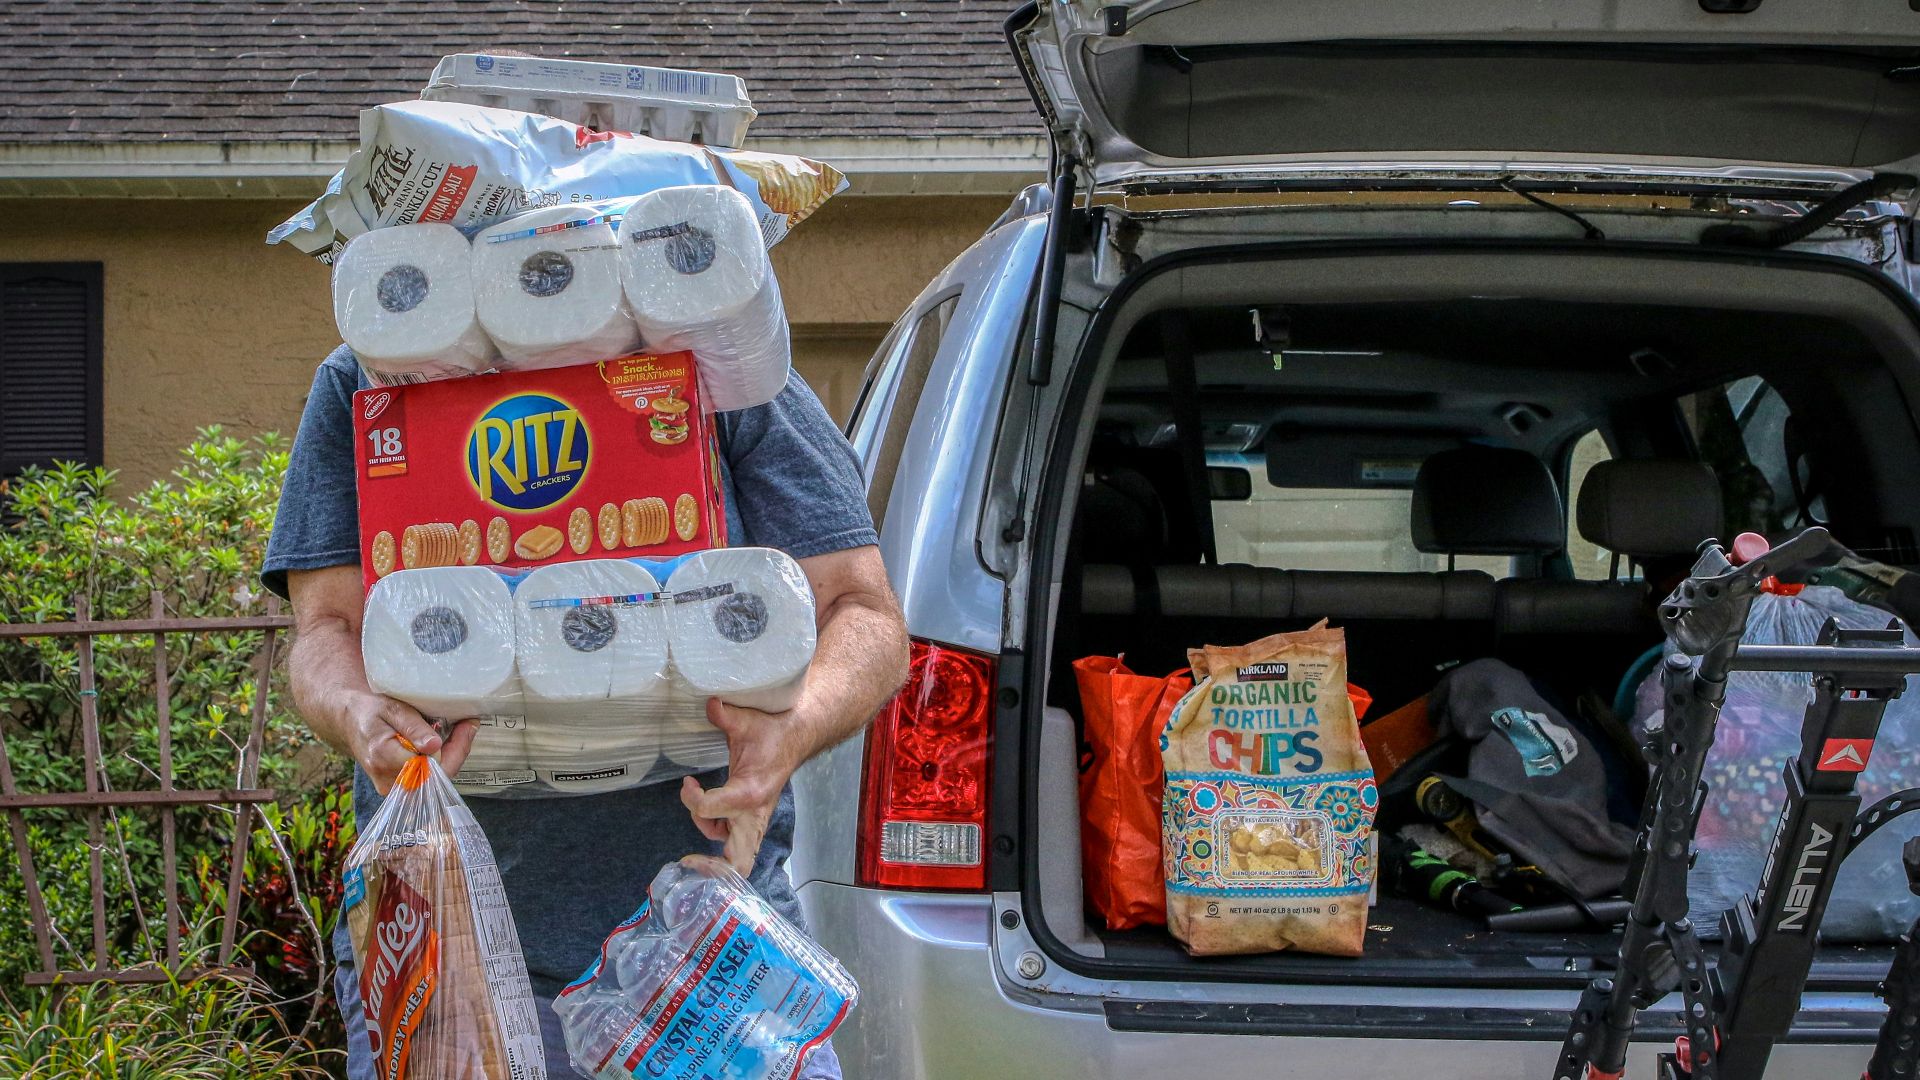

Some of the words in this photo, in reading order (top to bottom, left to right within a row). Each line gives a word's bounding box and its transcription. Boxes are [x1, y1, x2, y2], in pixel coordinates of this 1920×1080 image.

[394, 180, 415, 208] BRAND
[424, 195, 452, 223] LAYAN
[442, 173, 463, 195] SALT
[484, 185, 507, 216] PROMISE
[612, 367, 685, 384] INSPIRATIONS!
[623, 362, 655, 374] Snack
[366, 394, 388, 418] NABISCO
[368, 427, 402, 457] 18
[475, 408, 583, 502] RITZ
[530, 474, 571, 490] CRACKERS
[1239, 664, 1287, 675] KIRKLAND
[1211, 681, 1317, 706] ORGANIC
[1211, 707, 1319, 729] TORTILLA
[1208, 729, 1324, 775] CHIPS
[555, 769, 624, 782] KIRKLAND
[1777, 822, 1834, 931] ALLEN
[376, 902, 424, 980] Lee
[643, 1011, 672, 1047] BOTTLED
[673, 996, 682, 1008] AT
[683, 977, 697, 996] THE
[698, 940, 723, 975] SOURCE
[645, 1007, 706, 1078] CRYSTAL
[696, 937, 755, 1009] GEYSER
[708, 1002, 743, 1048] SPRING
[739, 961, 771, 1004] WATER
[389, 1027, 406, 1080] HONEY
[400, 977, 429, 1026] WHEAT
[685, 983, 743, 1056] NATURAL
[618, 1030, 640, 1057] CRYSTAL
[721, 1047, 728, 1055] BY
[727, 1039, 735, 1047] CG
[733, 1016, 751, 1038] ROXANE
[508, 1047, 519, 1080] trition
[517, 1064, 525, 1080] cts
[771, 1069, 778, 1078] FL
[775, 1062, 783, 1071] OZ
